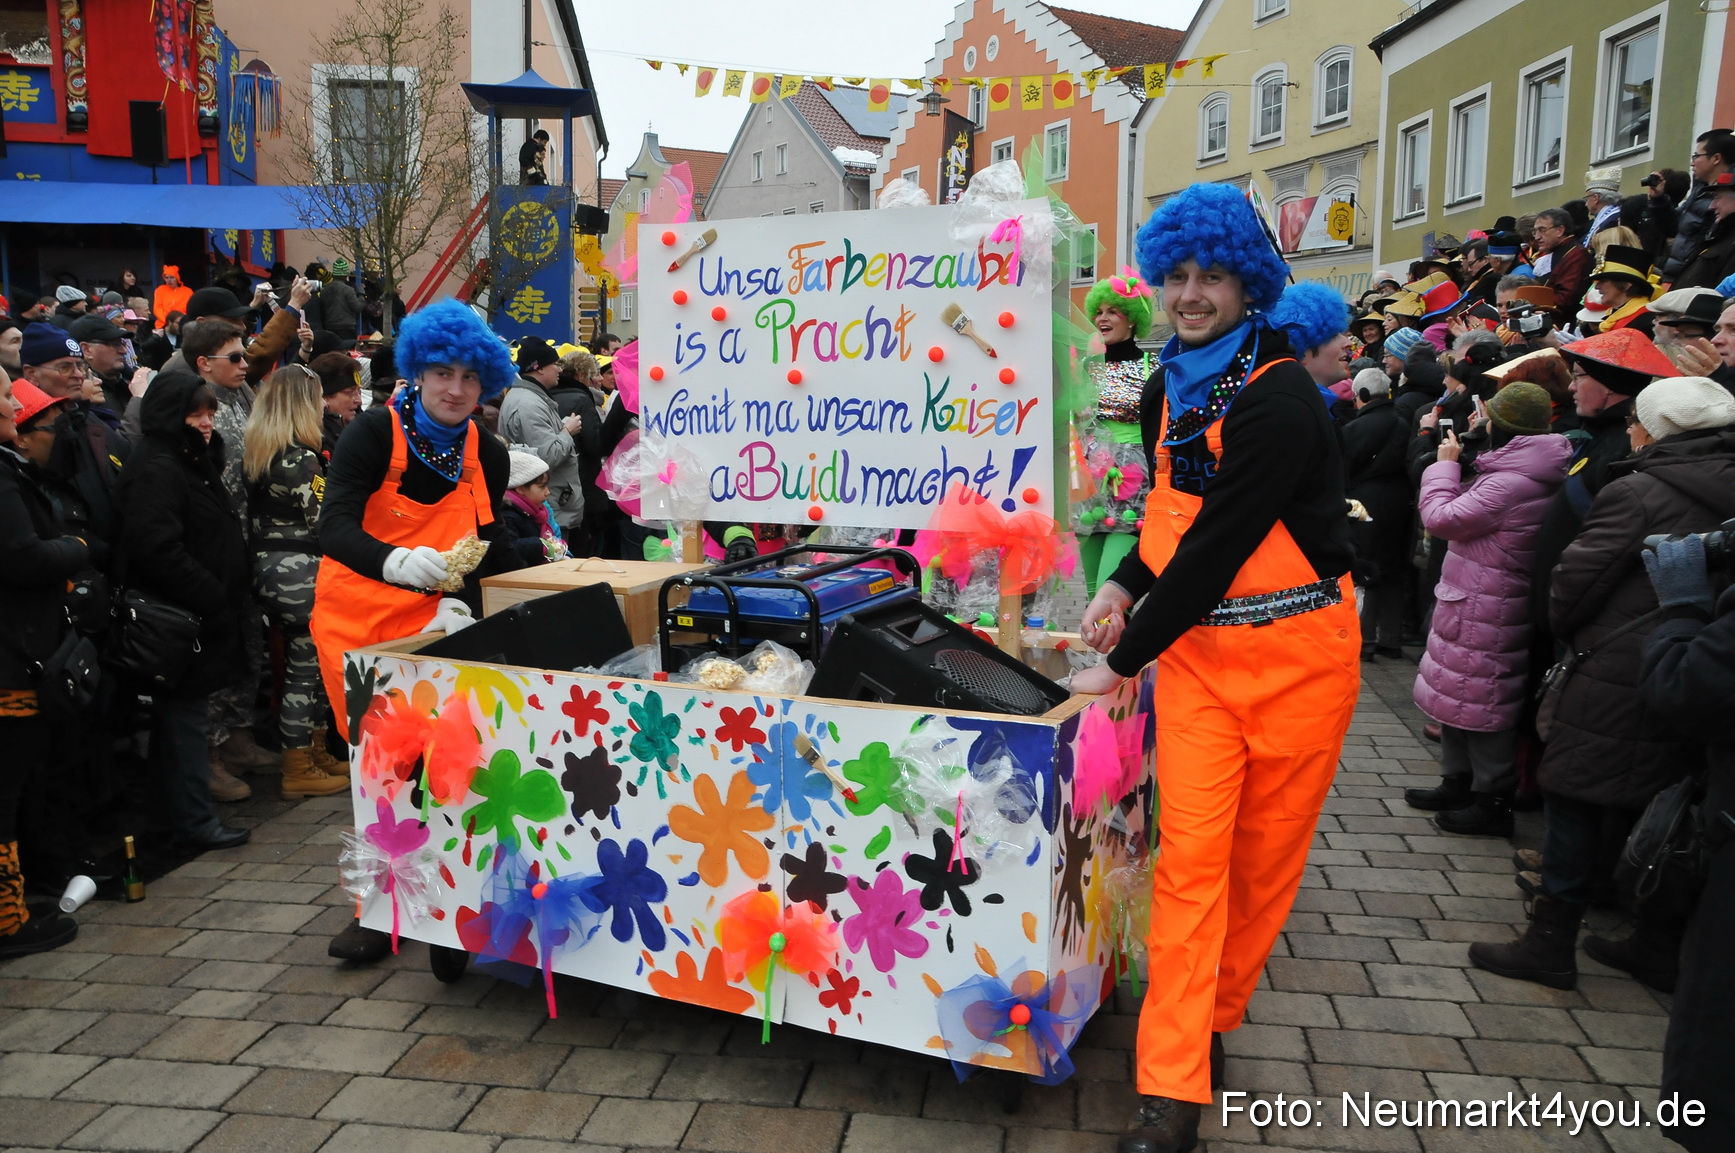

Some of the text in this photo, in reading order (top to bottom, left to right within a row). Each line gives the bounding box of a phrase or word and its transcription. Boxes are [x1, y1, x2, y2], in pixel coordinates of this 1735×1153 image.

[700, 256, 784, 300] Unsa
[675, 298, 916, 375] is a Pracht
[644, 371, 1038, 438] Womit ma unsam Kaiser
